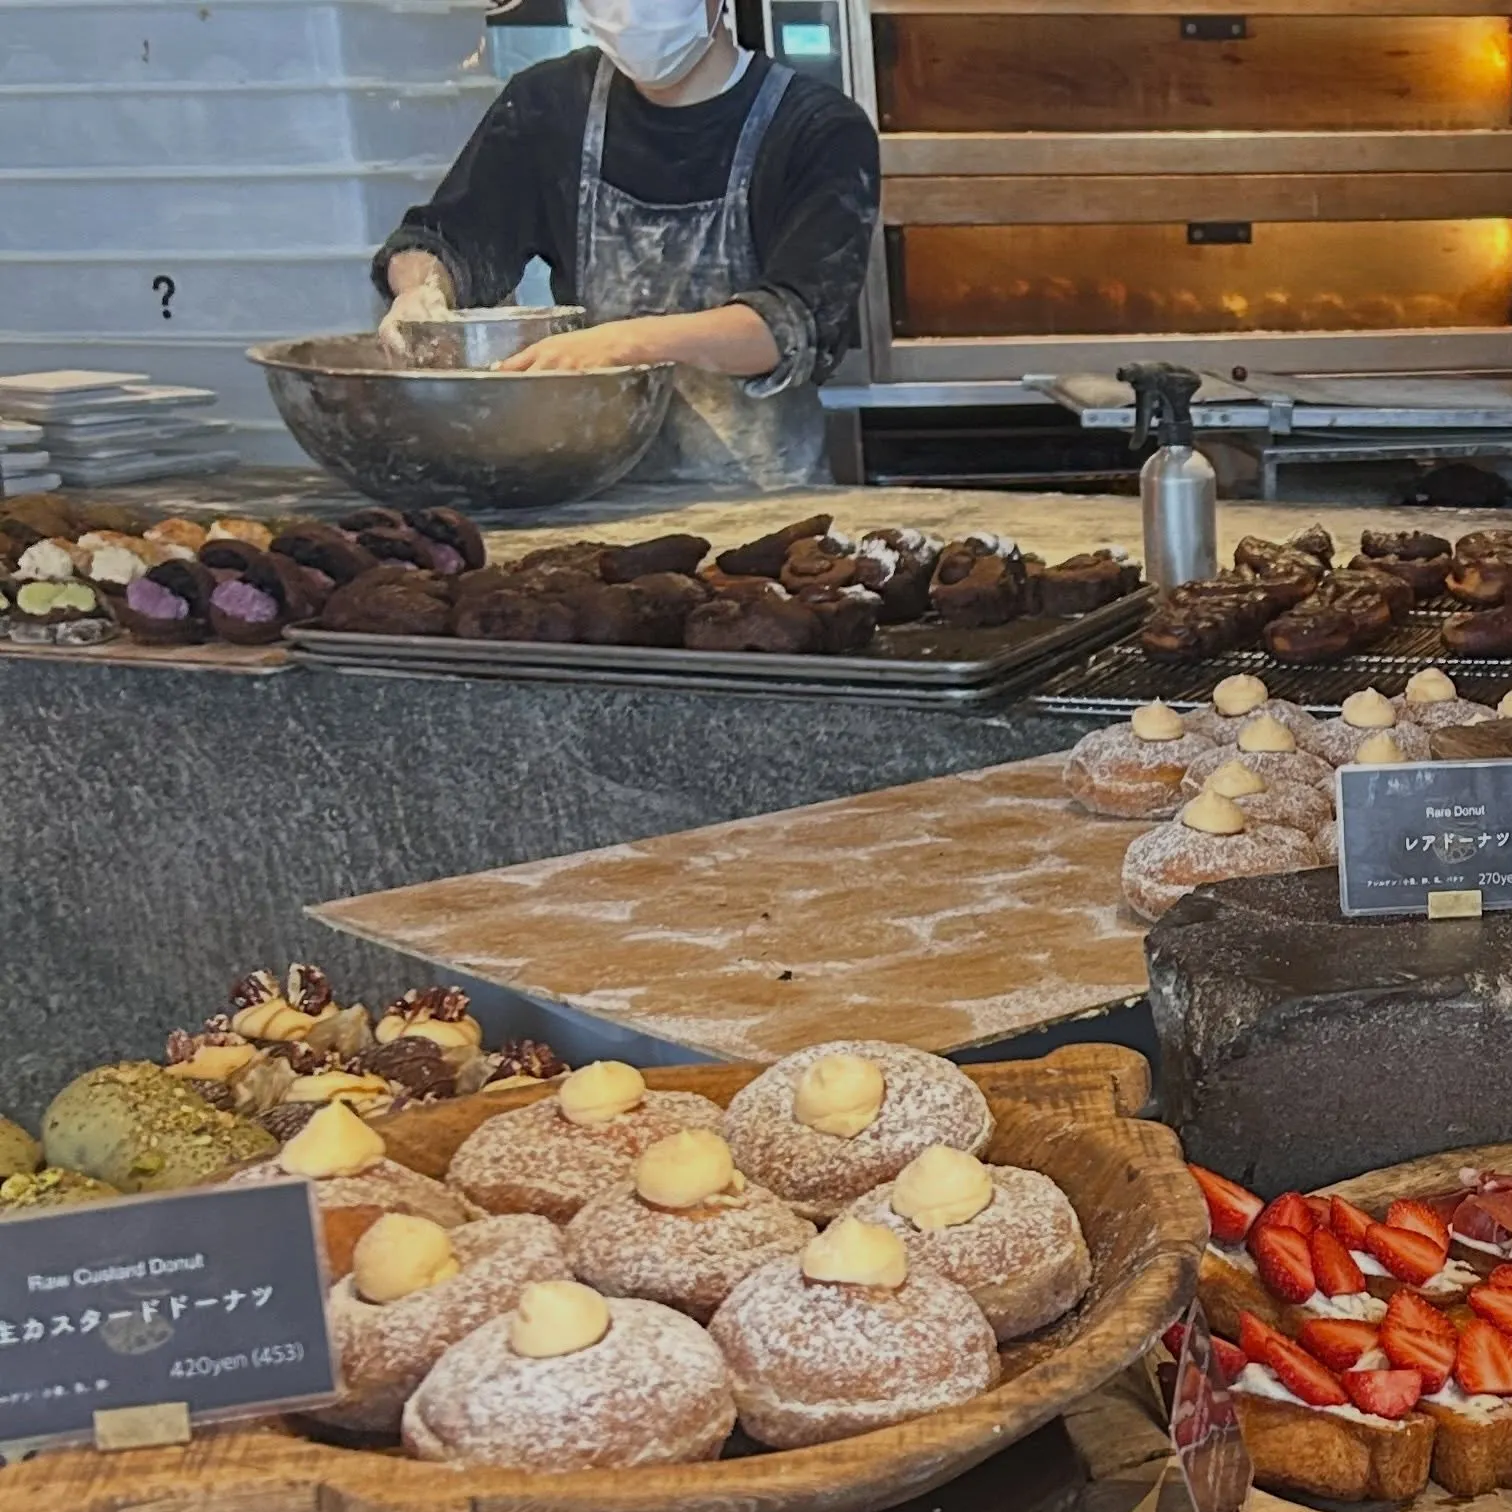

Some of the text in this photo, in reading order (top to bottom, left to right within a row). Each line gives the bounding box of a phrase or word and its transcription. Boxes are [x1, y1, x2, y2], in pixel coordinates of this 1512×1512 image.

[1426, 805, 1486, 818] Rare Donut
[1405, 832, 1510, 851] レアドーナツ
[149, 1252, 205, 1275] Donut
[0, 1286, 273, 1344] 生カスタードドーナツ
[170, 1342, 305, 1379] 420yen (453)
